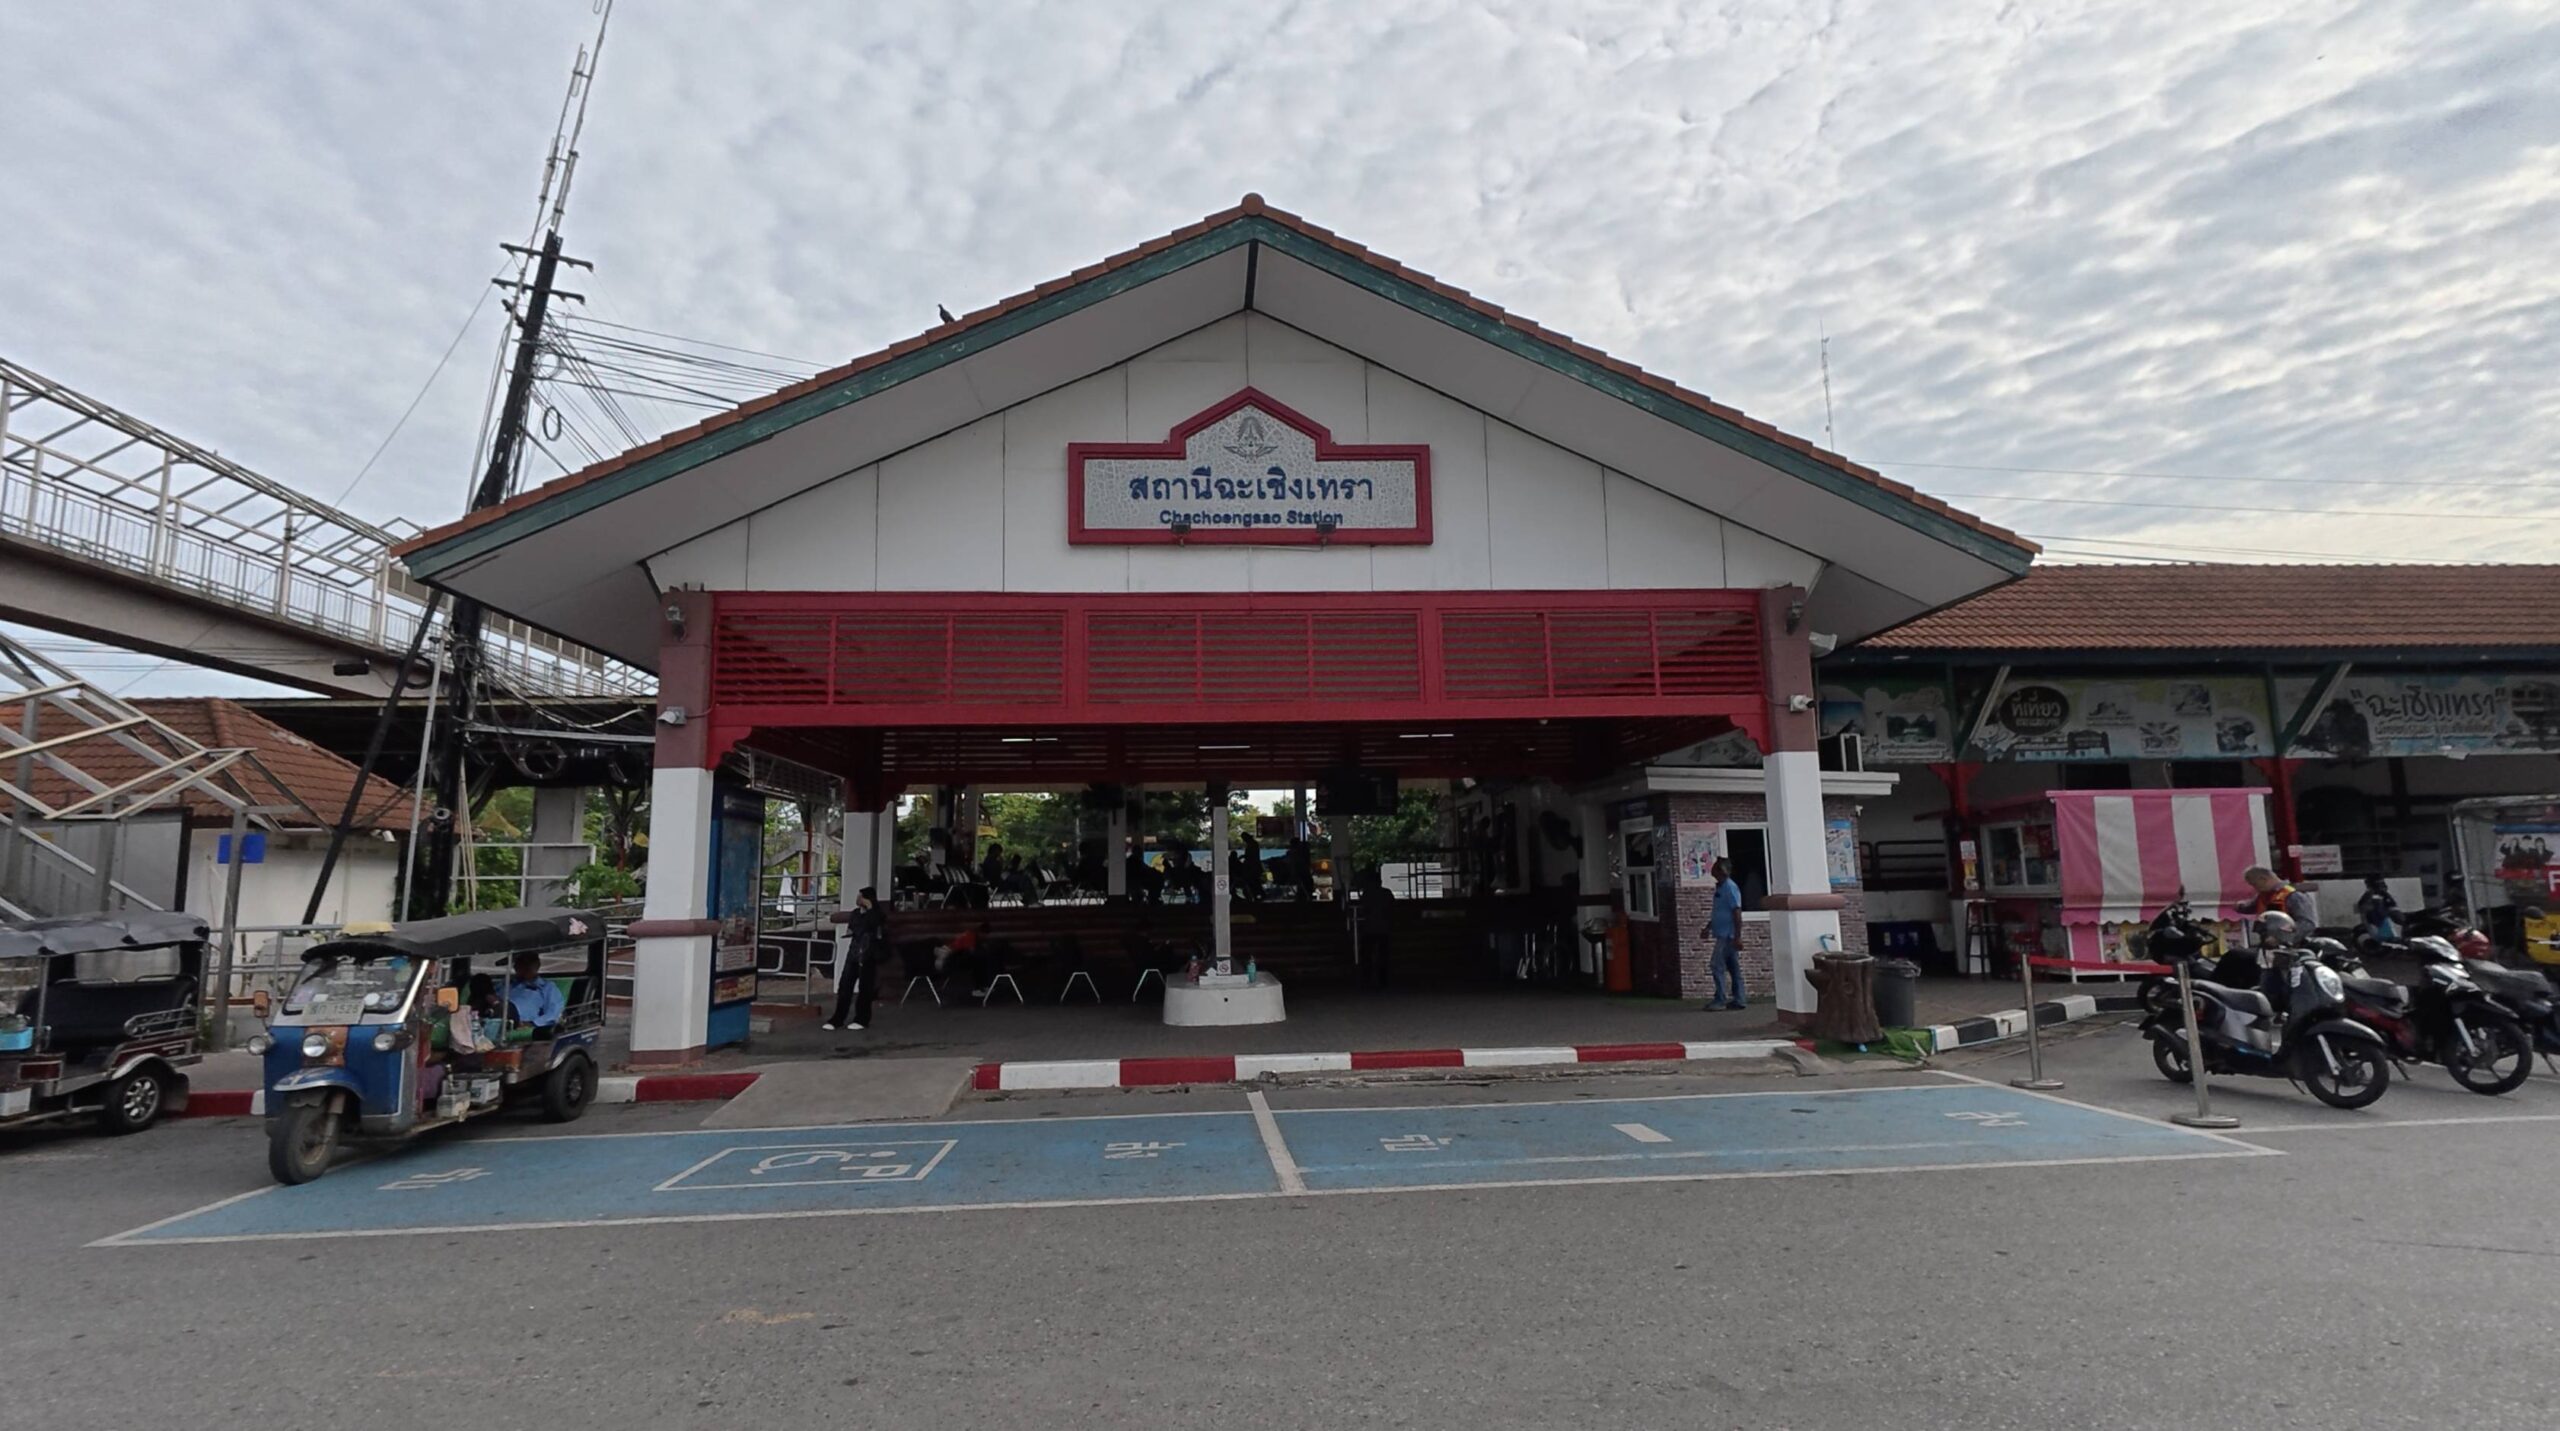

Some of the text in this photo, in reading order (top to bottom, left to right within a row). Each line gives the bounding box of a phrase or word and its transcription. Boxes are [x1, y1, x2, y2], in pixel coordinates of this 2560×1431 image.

[1129, 466, 1373, 501] สถานีฉะเชิงเทรา
[1159, 510, 1343, 527] Chachoengsao Station
